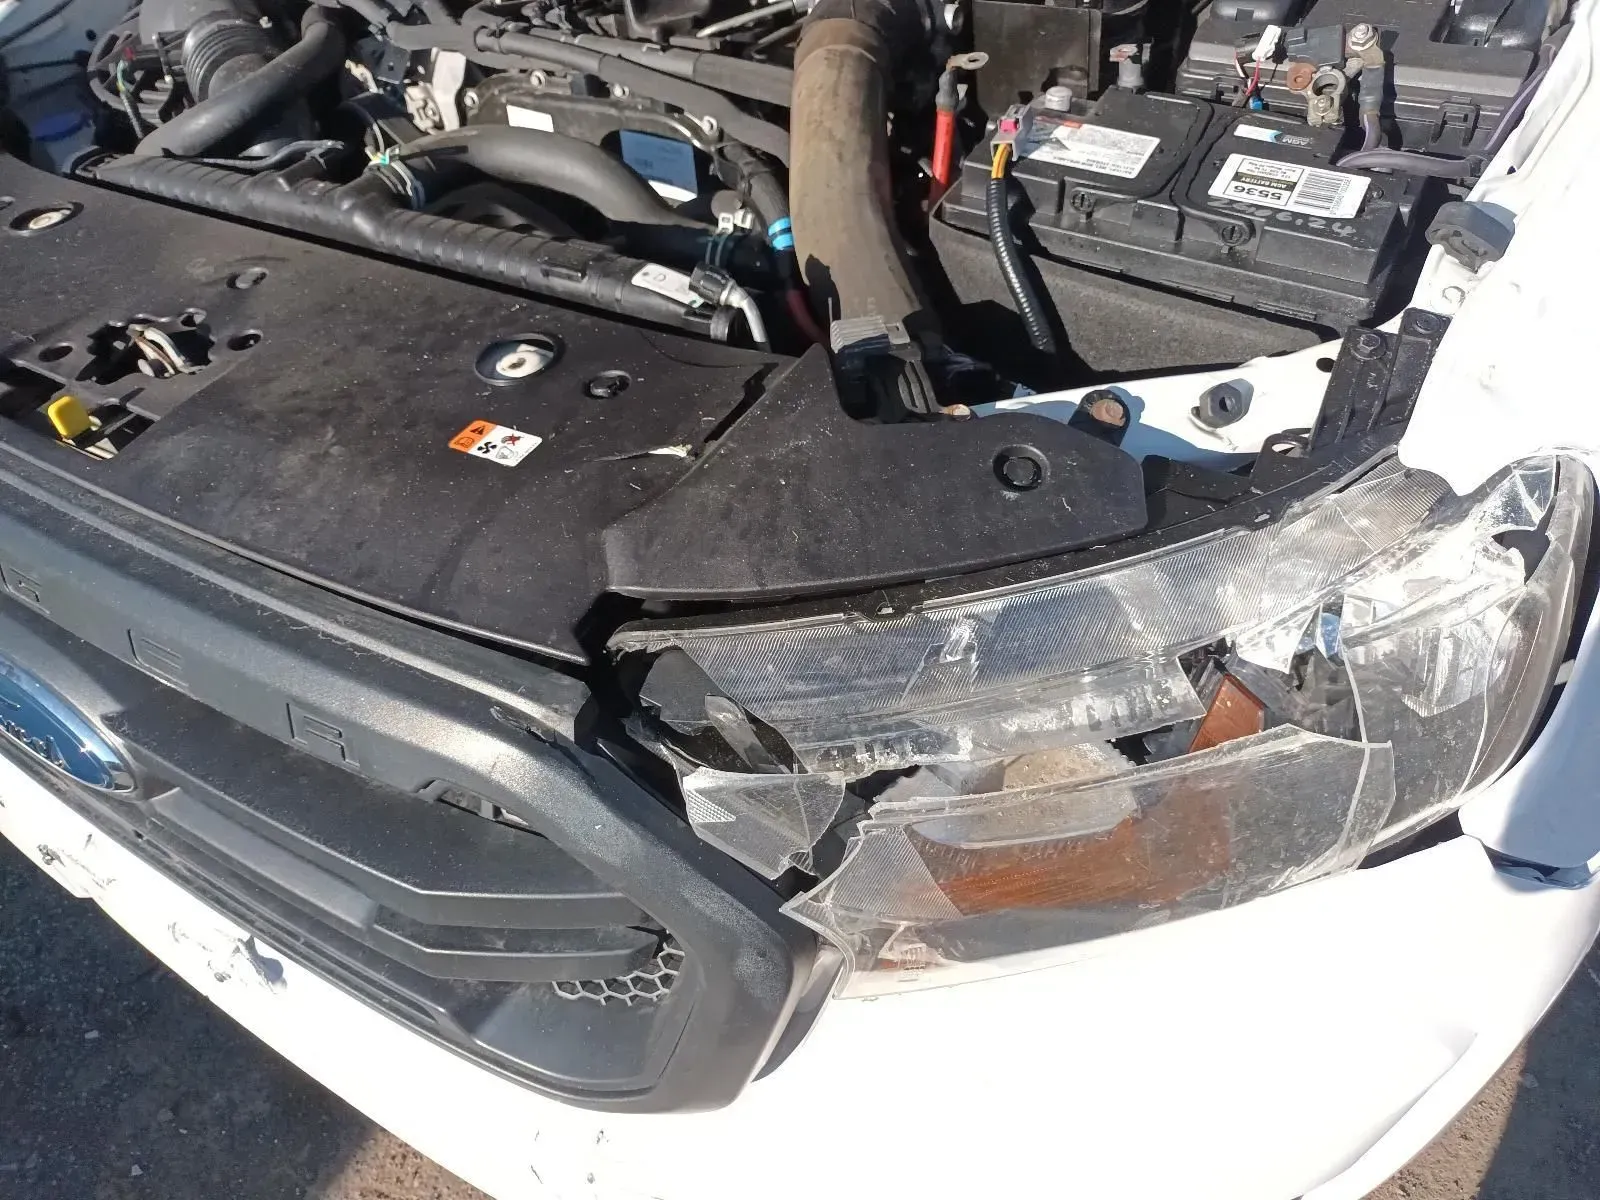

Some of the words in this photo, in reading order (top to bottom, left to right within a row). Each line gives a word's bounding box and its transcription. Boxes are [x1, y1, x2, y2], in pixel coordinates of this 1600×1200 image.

[1241, 176, 1270, 186] BATTERY
[1270, 182, 1288, 190] AGM
[1233, 185, 1283, 201] 5536
